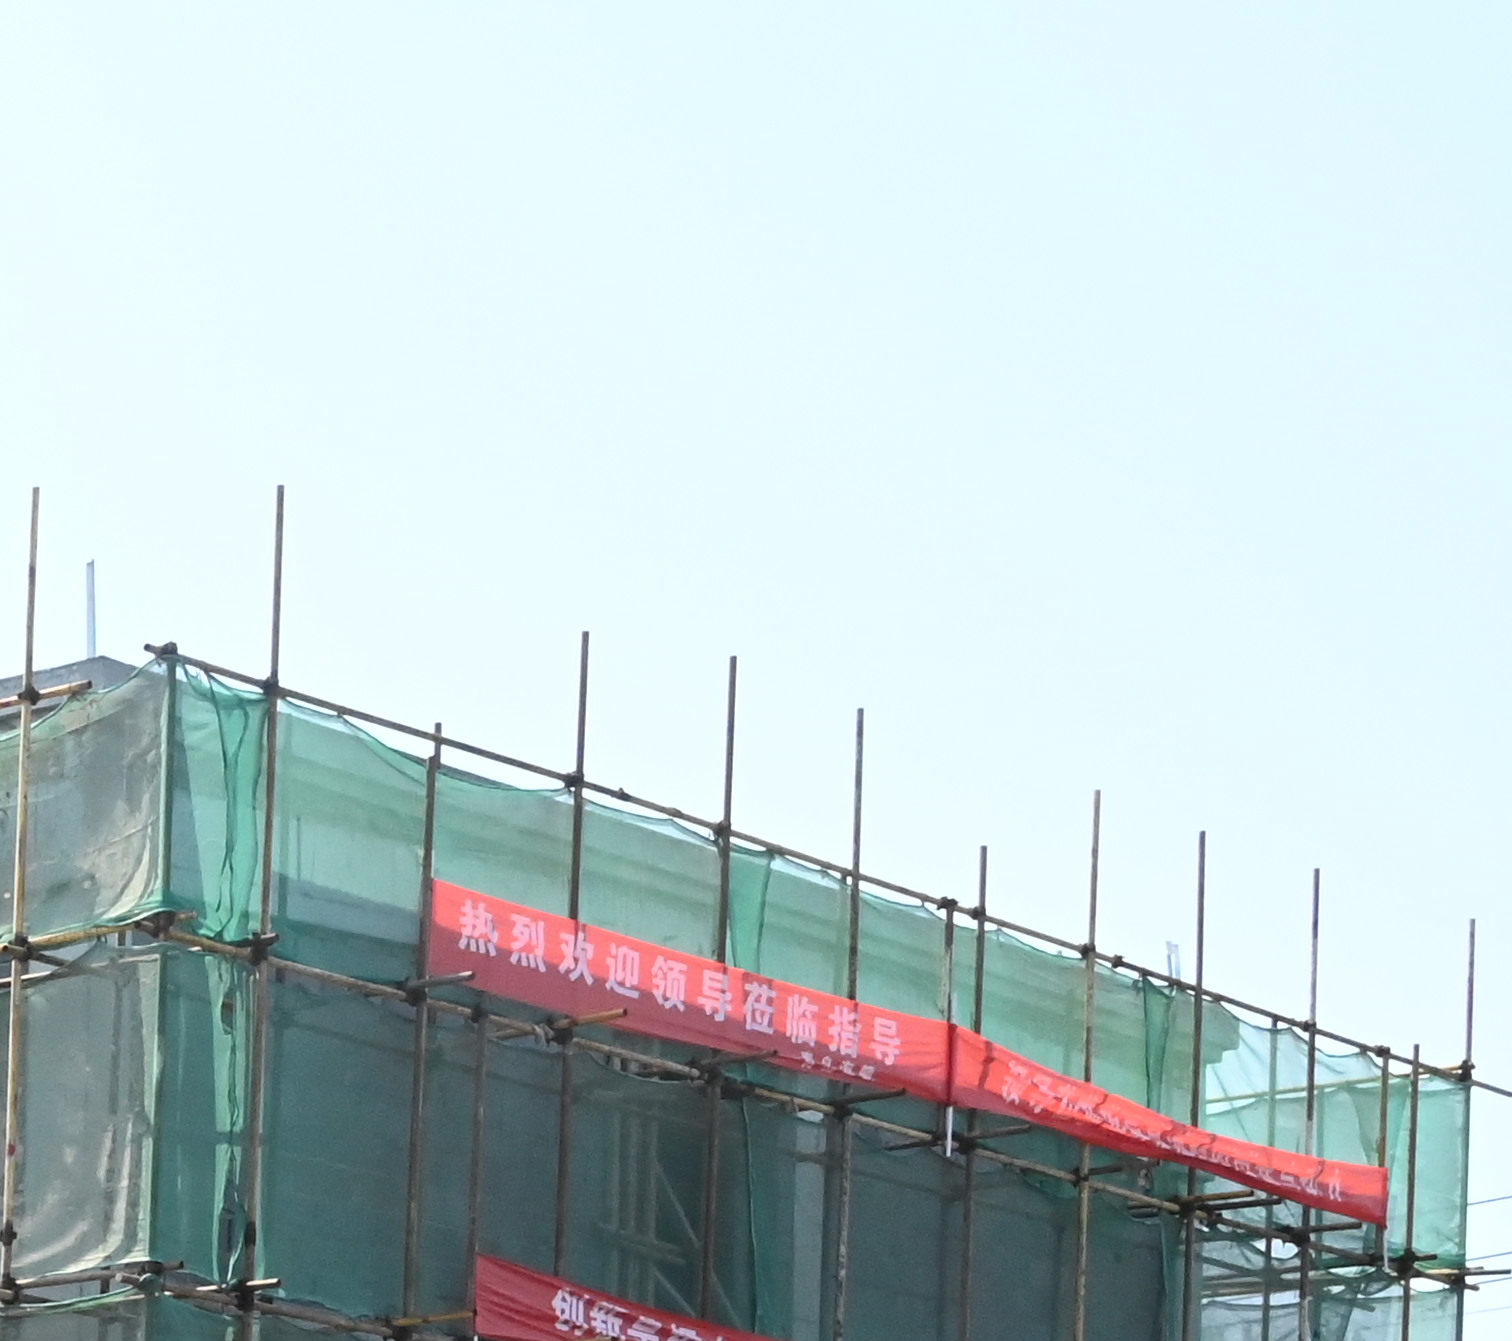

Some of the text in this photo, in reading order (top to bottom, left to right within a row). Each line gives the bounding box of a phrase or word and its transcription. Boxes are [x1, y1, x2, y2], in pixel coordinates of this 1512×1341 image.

[459, 899, 901, 1066] 热烈欢迎领导莅临指导
